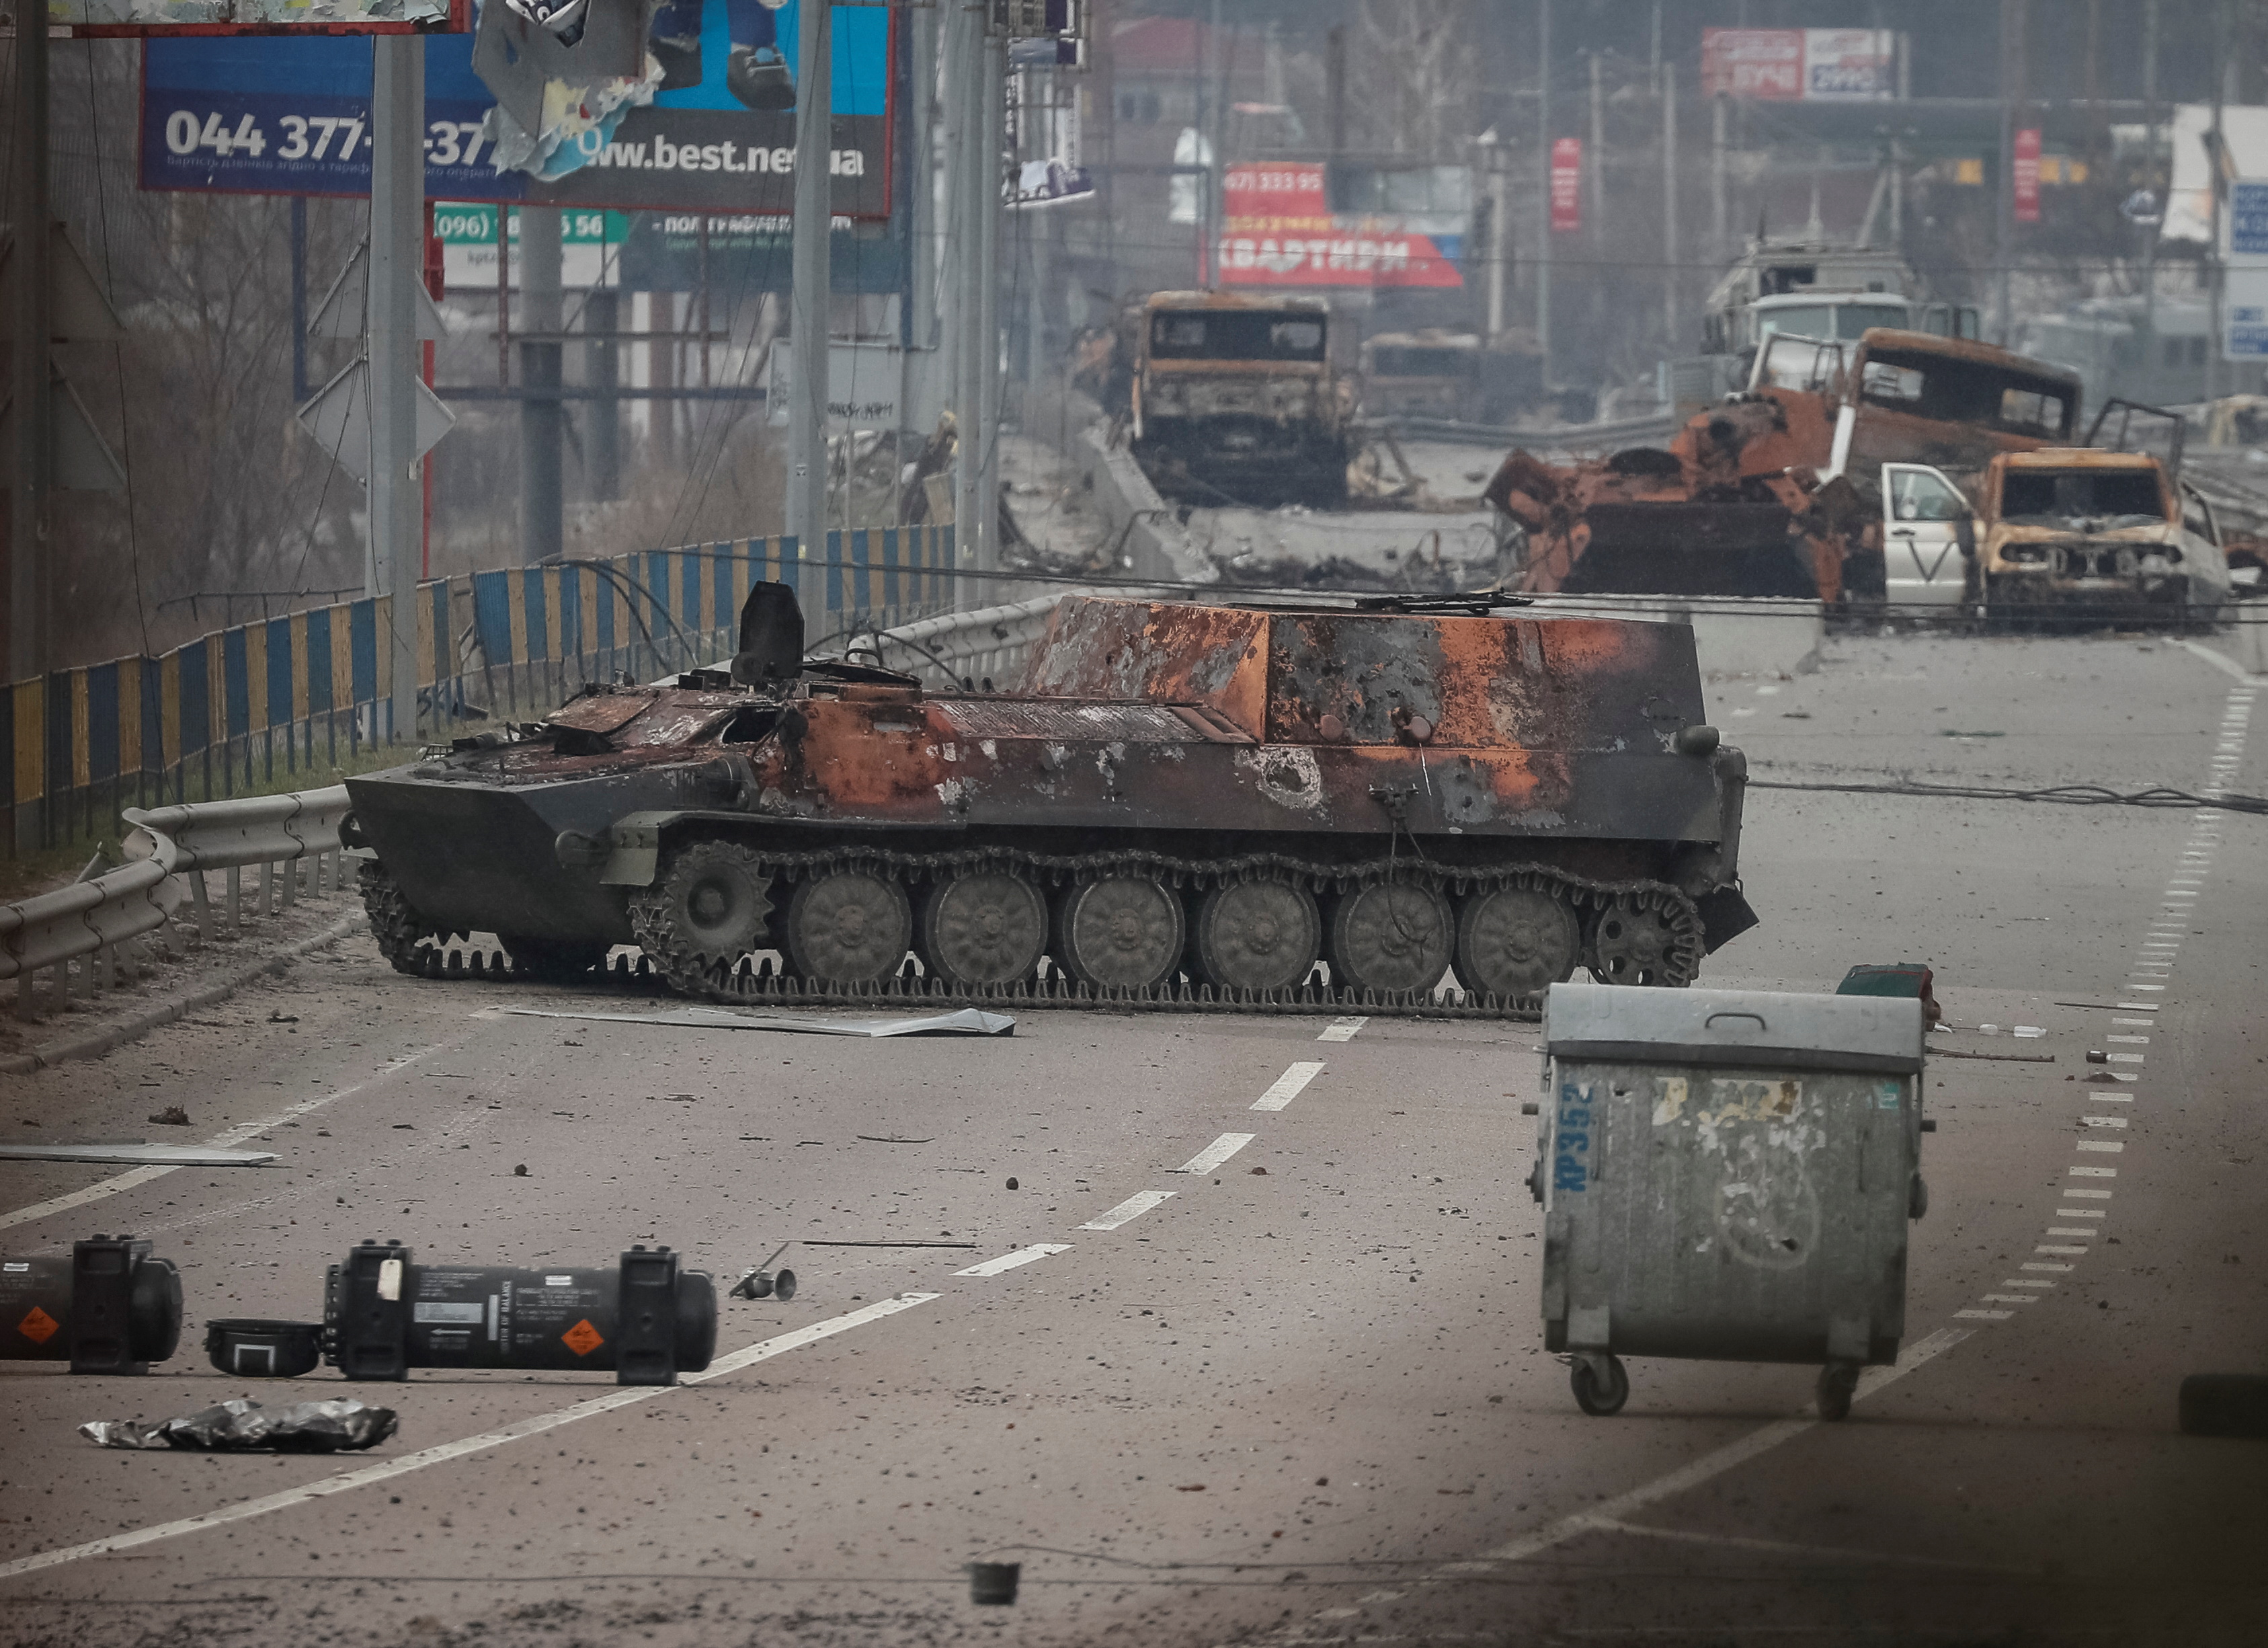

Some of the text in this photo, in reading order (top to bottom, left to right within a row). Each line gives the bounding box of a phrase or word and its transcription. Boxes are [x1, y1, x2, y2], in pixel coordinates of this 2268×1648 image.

[165, 110, 267, 158] 044
[167, 155, 218, 169] Вартість
[221, 158, 274, 169] дзвінків
[586, 134, 864, 177] ww.best.nea
[434, 211, 489, 239] (096)
[575, 214, 603, 237] 56
[1907, 539, 1953, 582] V
[499, 1280, 512, 1313] BALANCE
